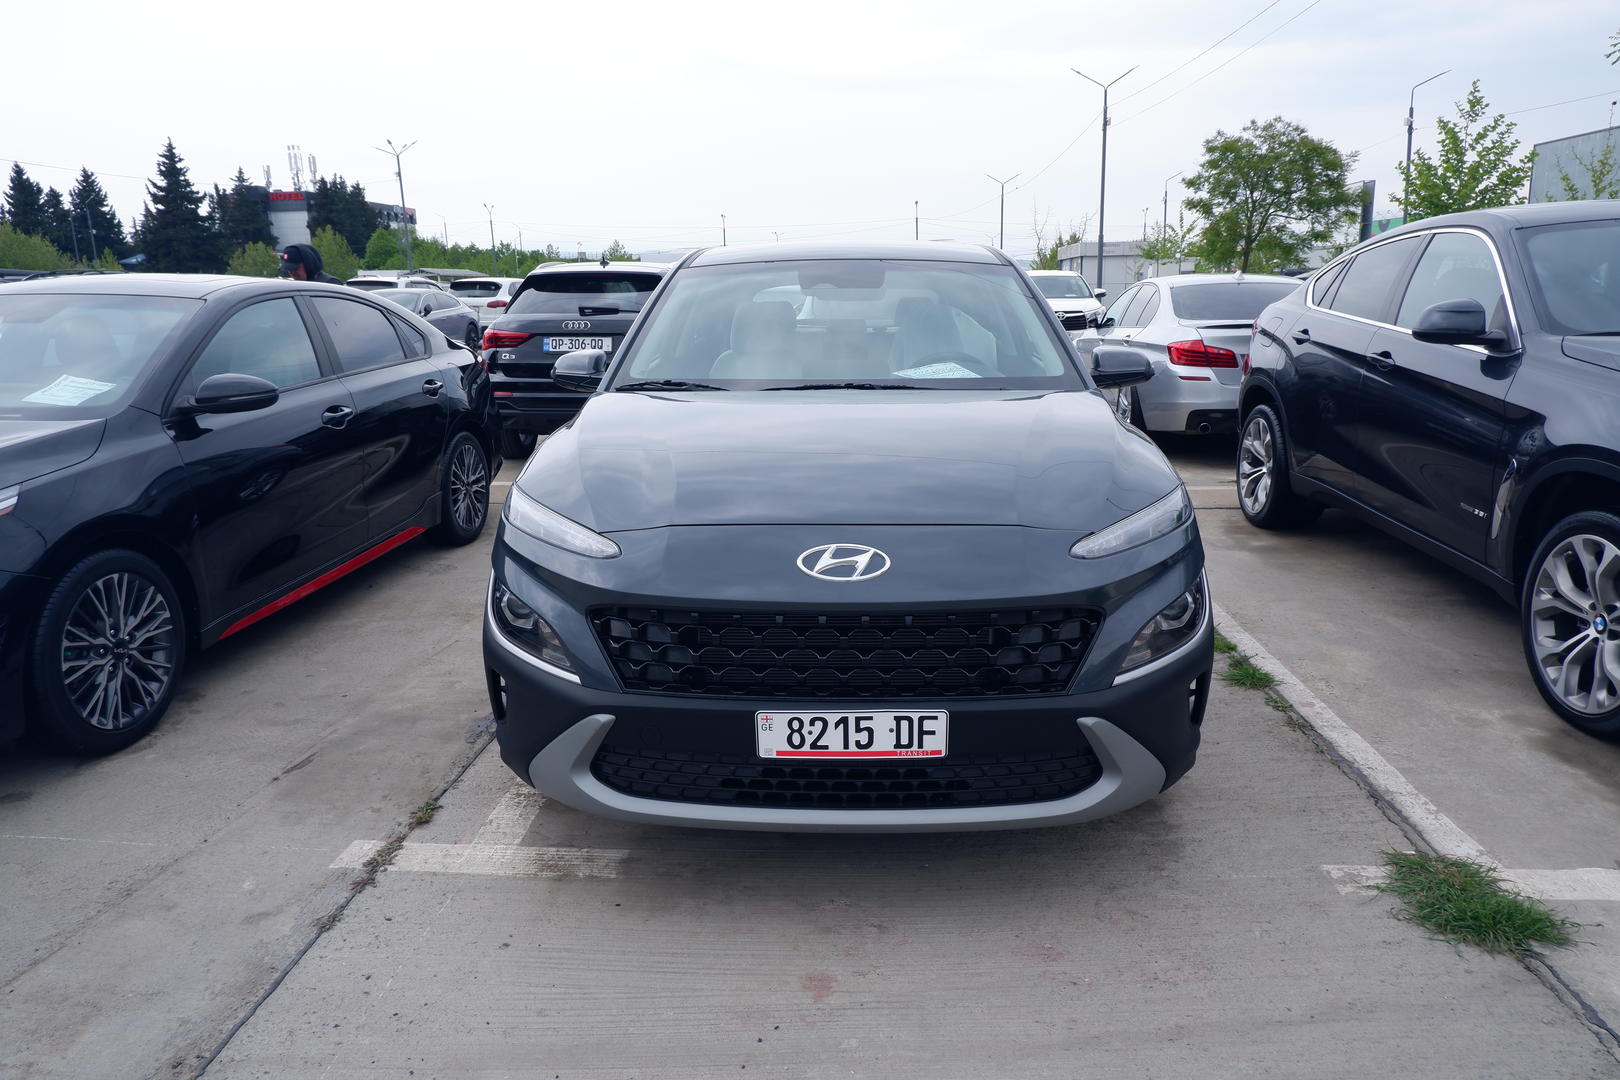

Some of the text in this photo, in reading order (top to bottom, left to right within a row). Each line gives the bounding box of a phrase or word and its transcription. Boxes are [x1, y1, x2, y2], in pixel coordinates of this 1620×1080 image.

[269, 192, 304, 200] HOTEL
[551, 338, 603, 350] QP-306-QQ
[760, 723, 774, 732] GE
[786, 715, 940, 751] 8215 DF
